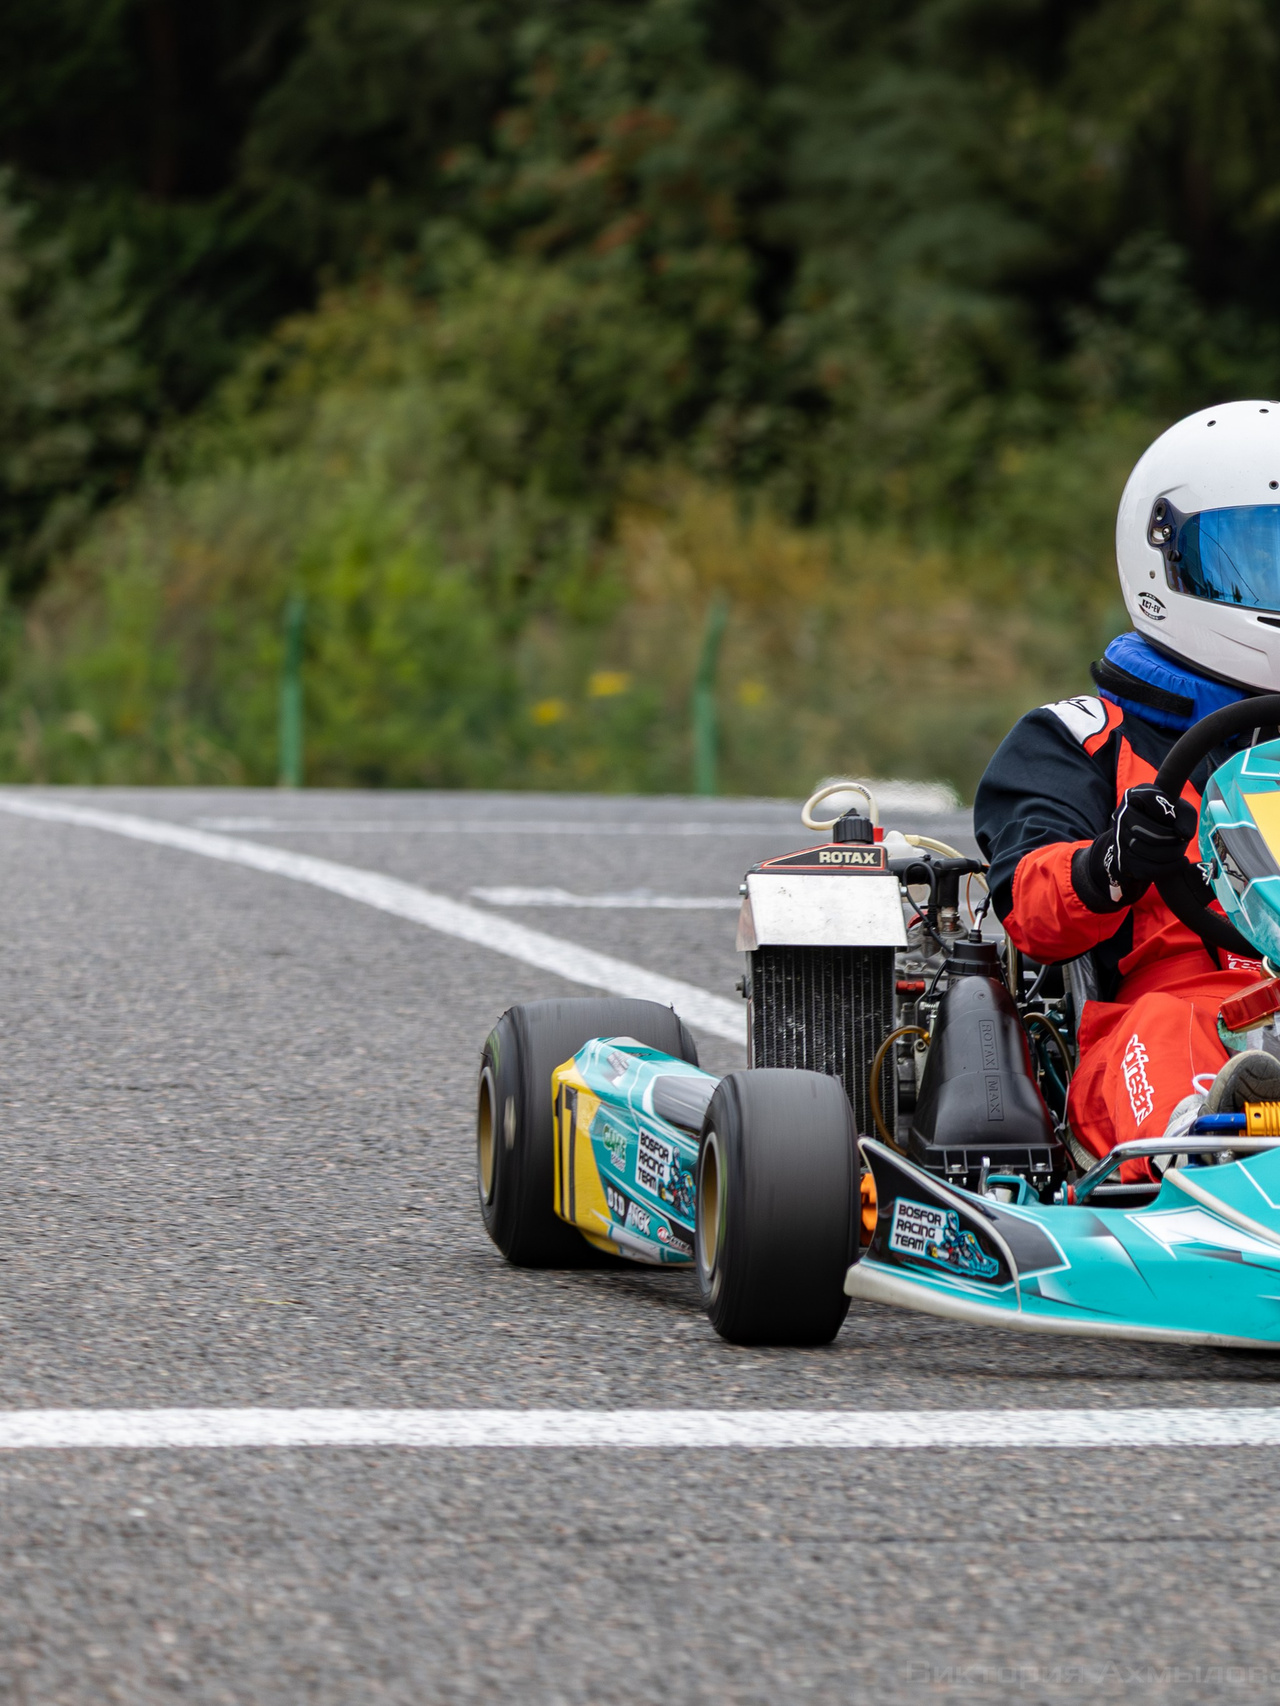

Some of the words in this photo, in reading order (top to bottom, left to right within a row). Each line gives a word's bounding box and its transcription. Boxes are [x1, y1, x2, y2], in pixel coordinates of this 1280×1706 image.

[819, 851, 875, 864] ROTAX
[981, 1024, 996, 1068] ROTAX
[987, 1080, 1000, 1113] MAX
[553, 1083, 579, 1224] 17
[640, 1131, 669, 1162] BOSFOR
[639, 1149, 665, 1177] RACING
[638, 1167, 658, 1192] TEAM
[896, 1218, 936, 1239] RACING
[898, 1204, 942, 1227] BOSFOR
[895, 1234, 925, 1251] TEAM
